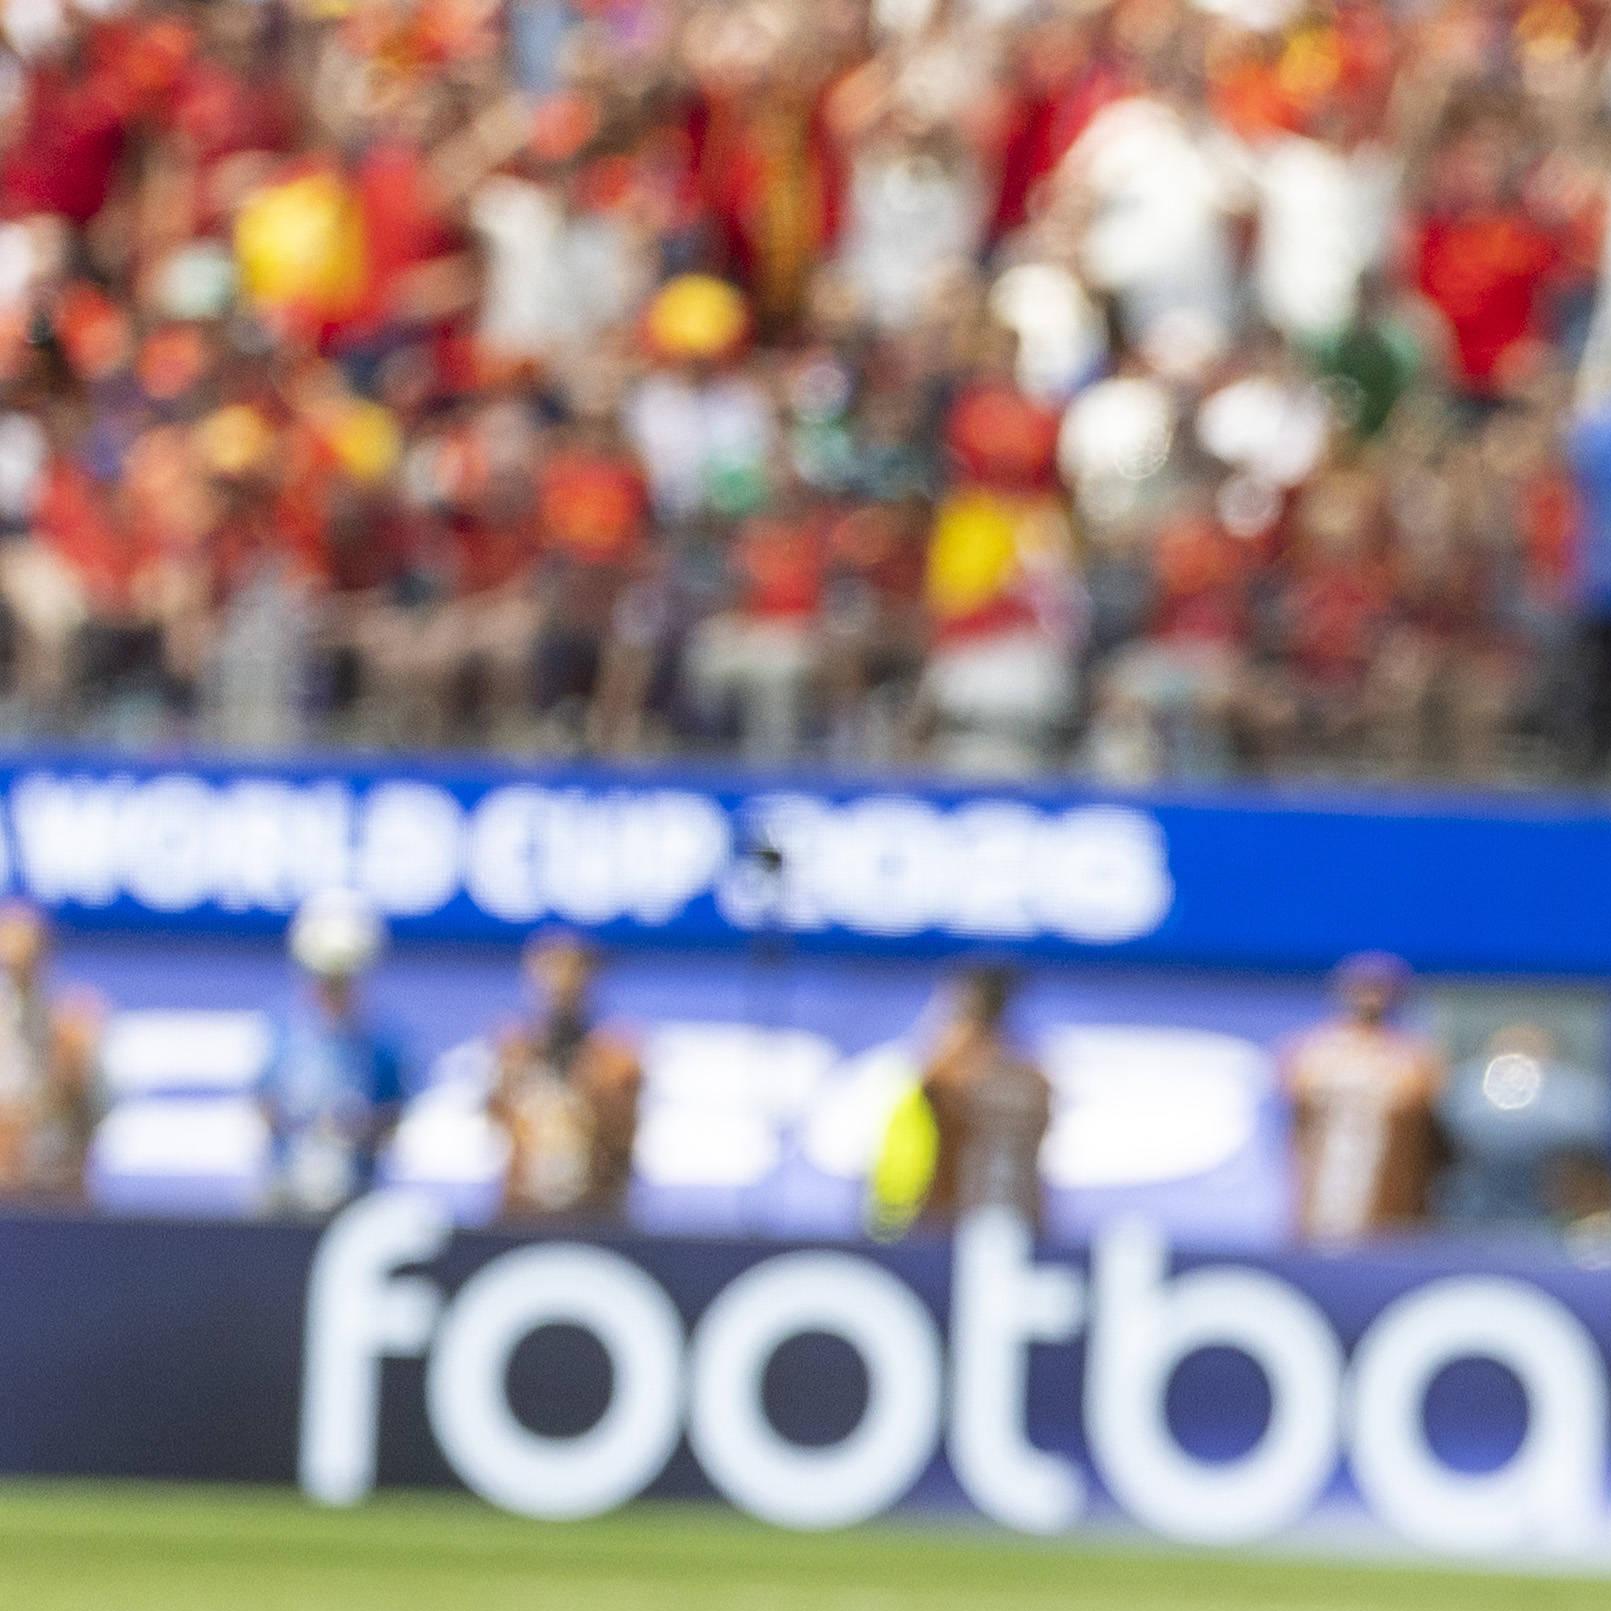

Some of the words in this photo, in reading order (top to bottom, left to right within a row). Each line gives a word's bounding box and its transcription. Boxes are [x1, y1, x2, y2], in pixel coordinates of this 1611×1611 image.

[12, 776, 462, 918] WORLD
[466, 783, 732, 926] CUP
[716, 792, 1173, 946] 2026
